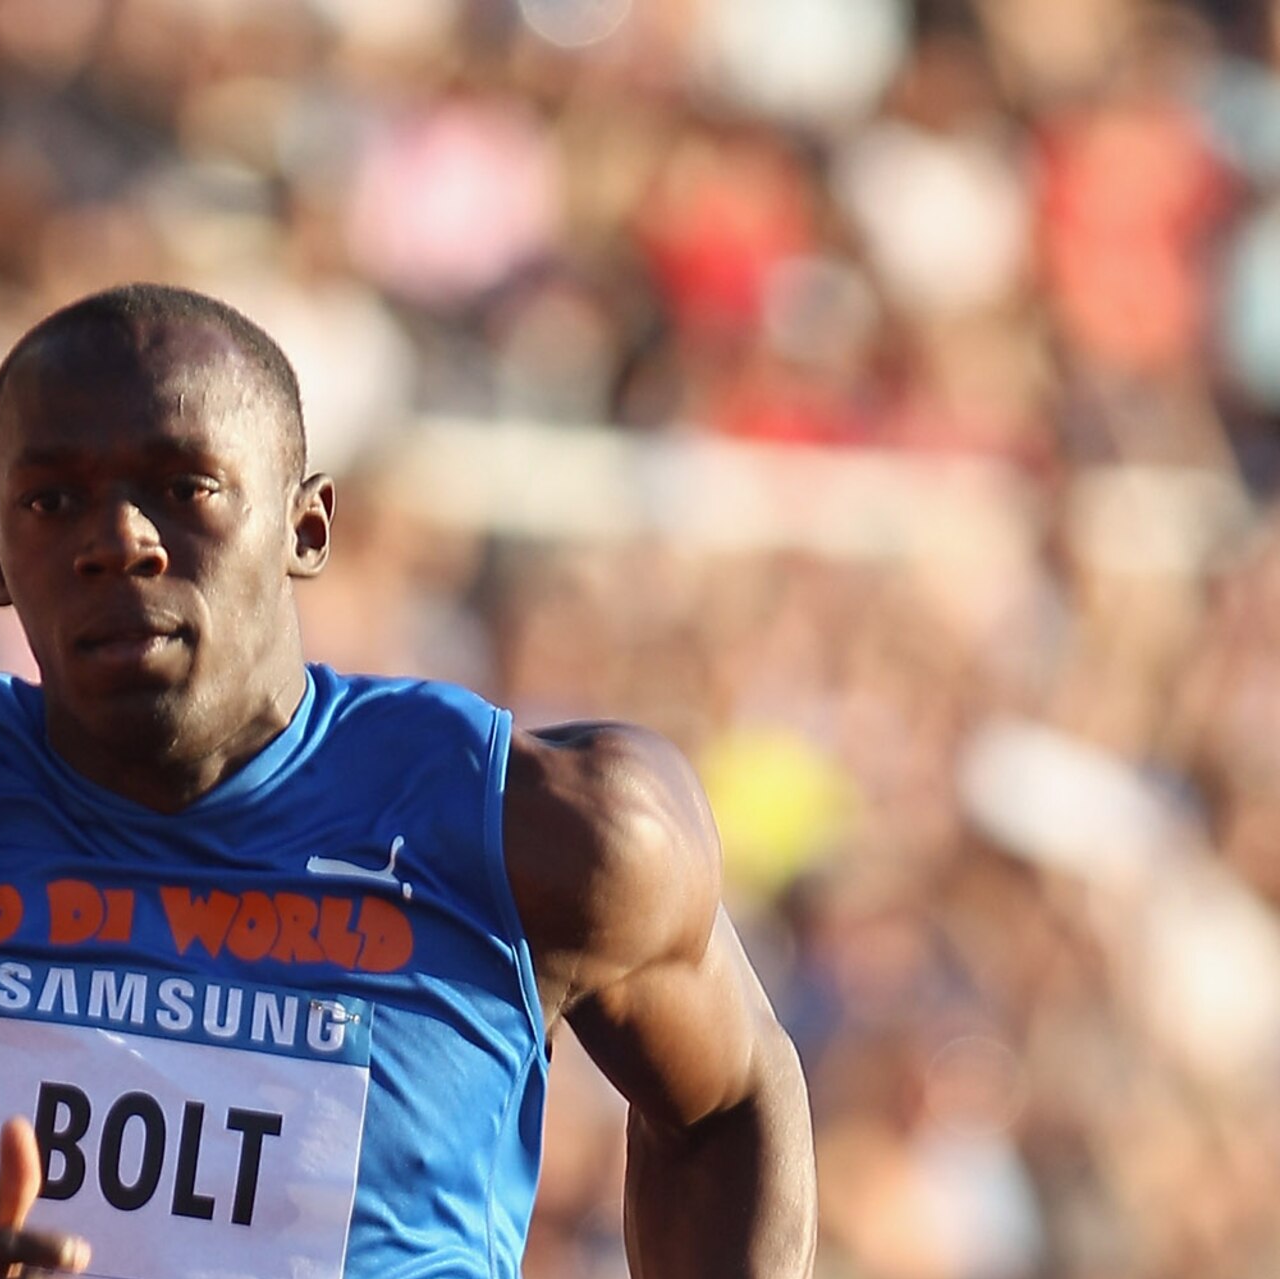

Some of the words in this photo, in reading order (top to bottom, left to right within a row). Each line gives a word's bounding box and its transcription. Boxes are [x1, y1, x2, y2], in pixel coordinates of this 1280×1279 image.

[48, 879, 134, 944] DI
[159, 885, 414, 974] WORLD
[37, 1080, 284, 1227] BOLT
